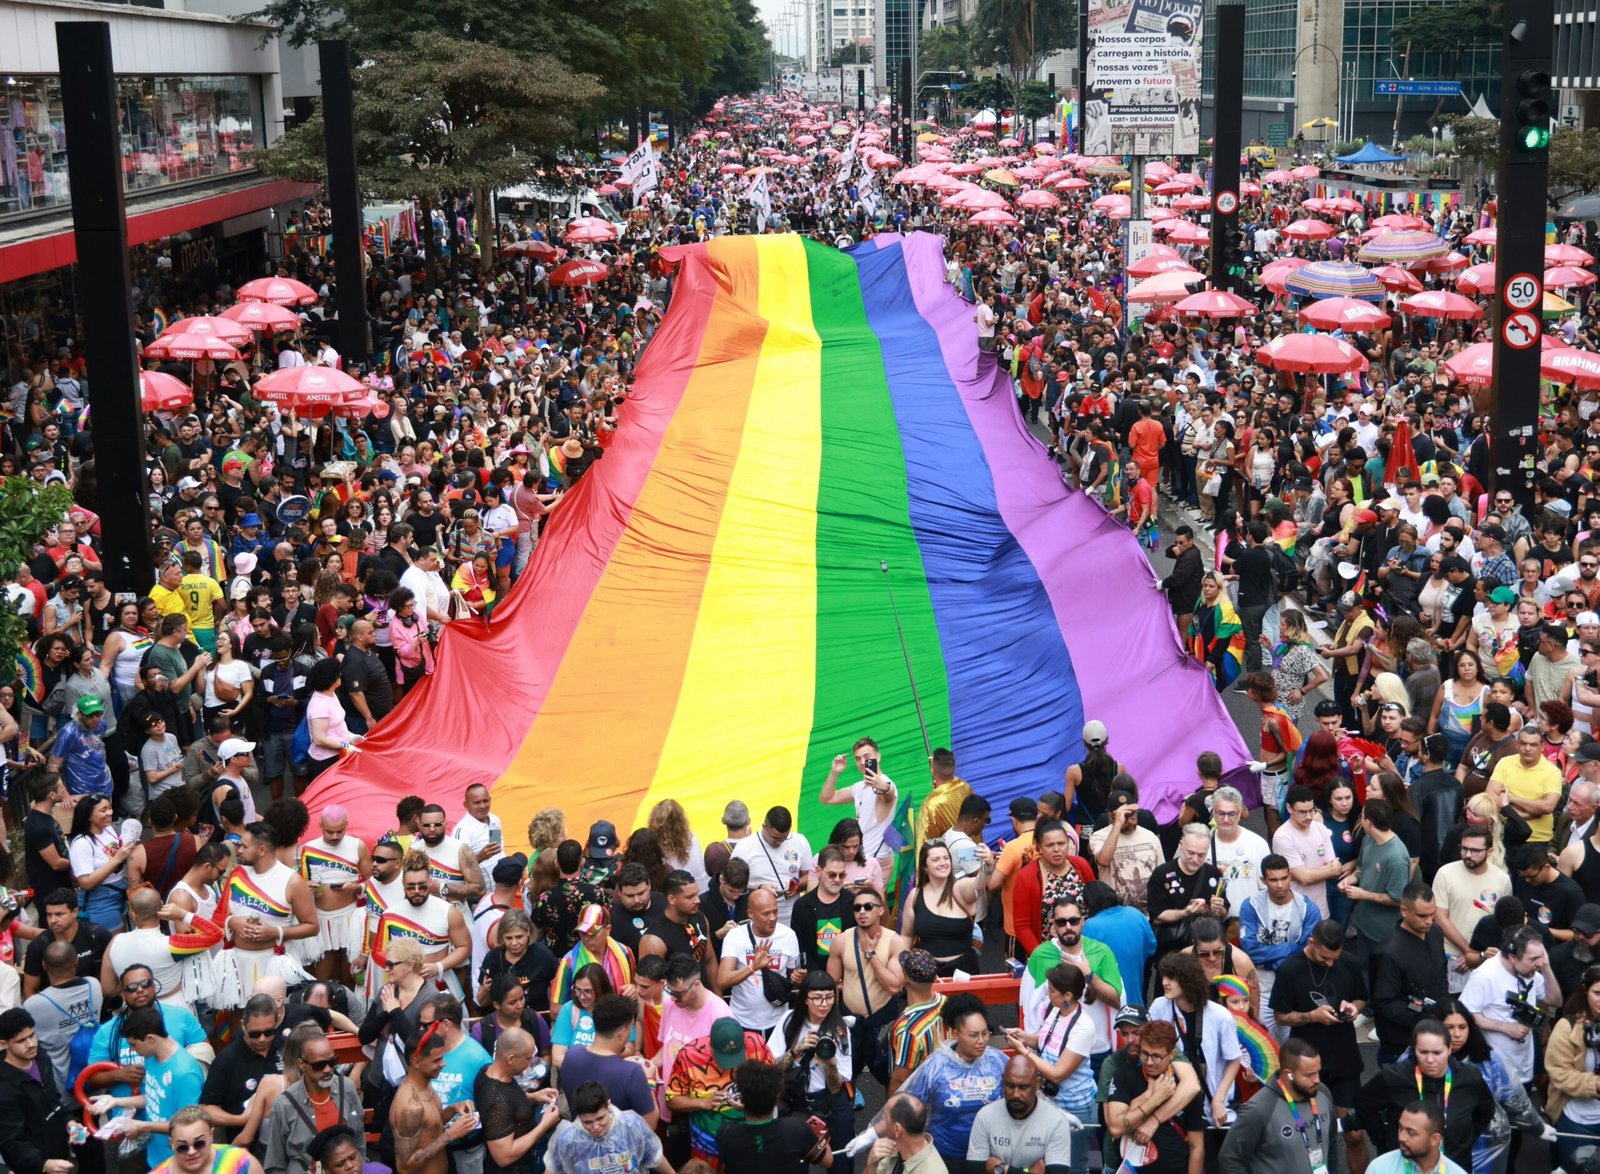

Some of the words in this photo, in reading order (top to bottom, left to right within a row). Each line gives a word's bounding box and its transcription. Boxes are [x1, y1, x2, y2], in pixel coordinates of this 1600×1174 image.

[1097, 51, 1142, 59] carregam
[1153, 49, 1192, 58] história,
[1143, 77, 1172, 85] futuro
[1140, 115, 1152, 123] SÃO
[181, 236, 216, 272] marisa
[569, 265, 599, 278] BRAHMA
[1511, 281, 1535, 298] 50
[1465, 375, 1486, 383] AMSTEL
[191, 591, 199, 611] 9
[993, 1136, 1011, 1147] 169
